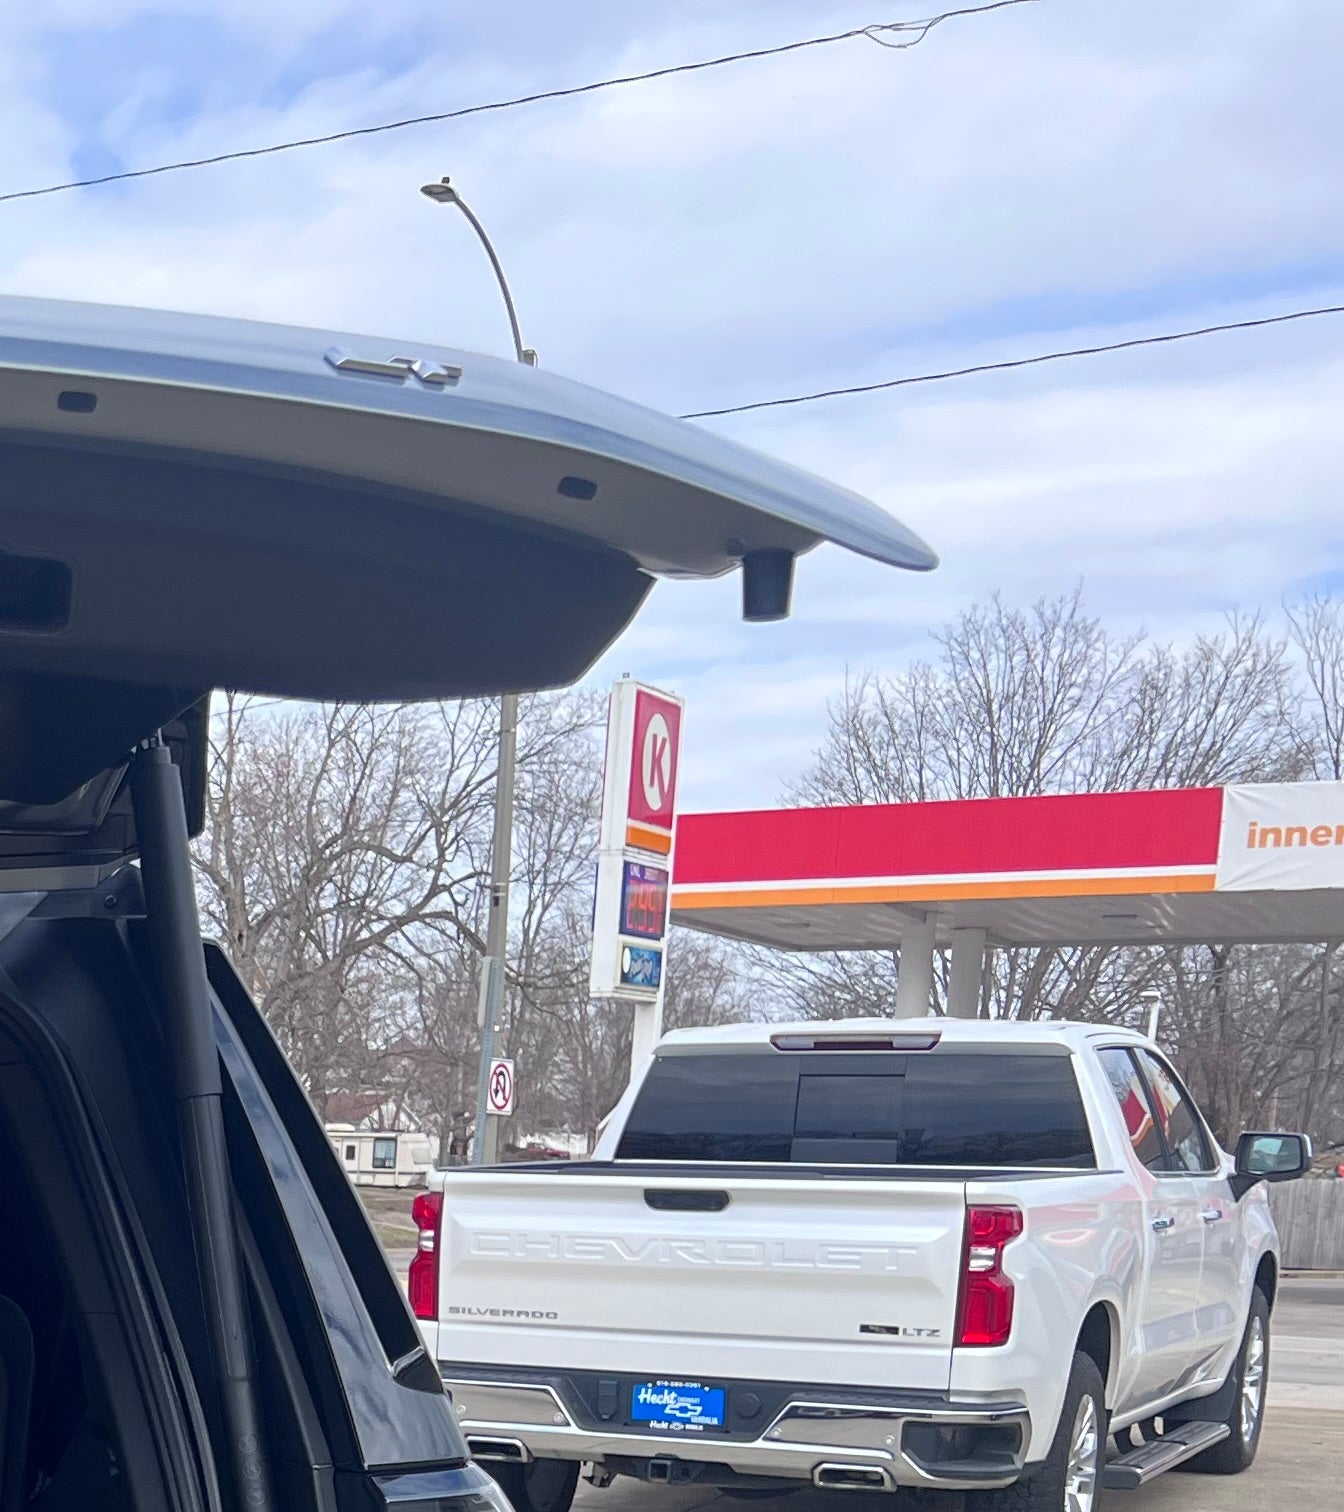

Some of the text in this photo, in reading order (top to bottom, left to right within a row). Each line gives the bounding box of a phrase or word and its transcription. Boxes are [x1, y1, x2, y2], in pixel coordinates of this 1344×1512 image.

[649, 733, 667, 806] K
[469, 1231, 918, 1271] CHEVROLET
[448, 1306, 558, 1320] SILVERADO
[902, 1327, 941, 1337] LTZ
[637, 1387, 678, 1405] Hecht
